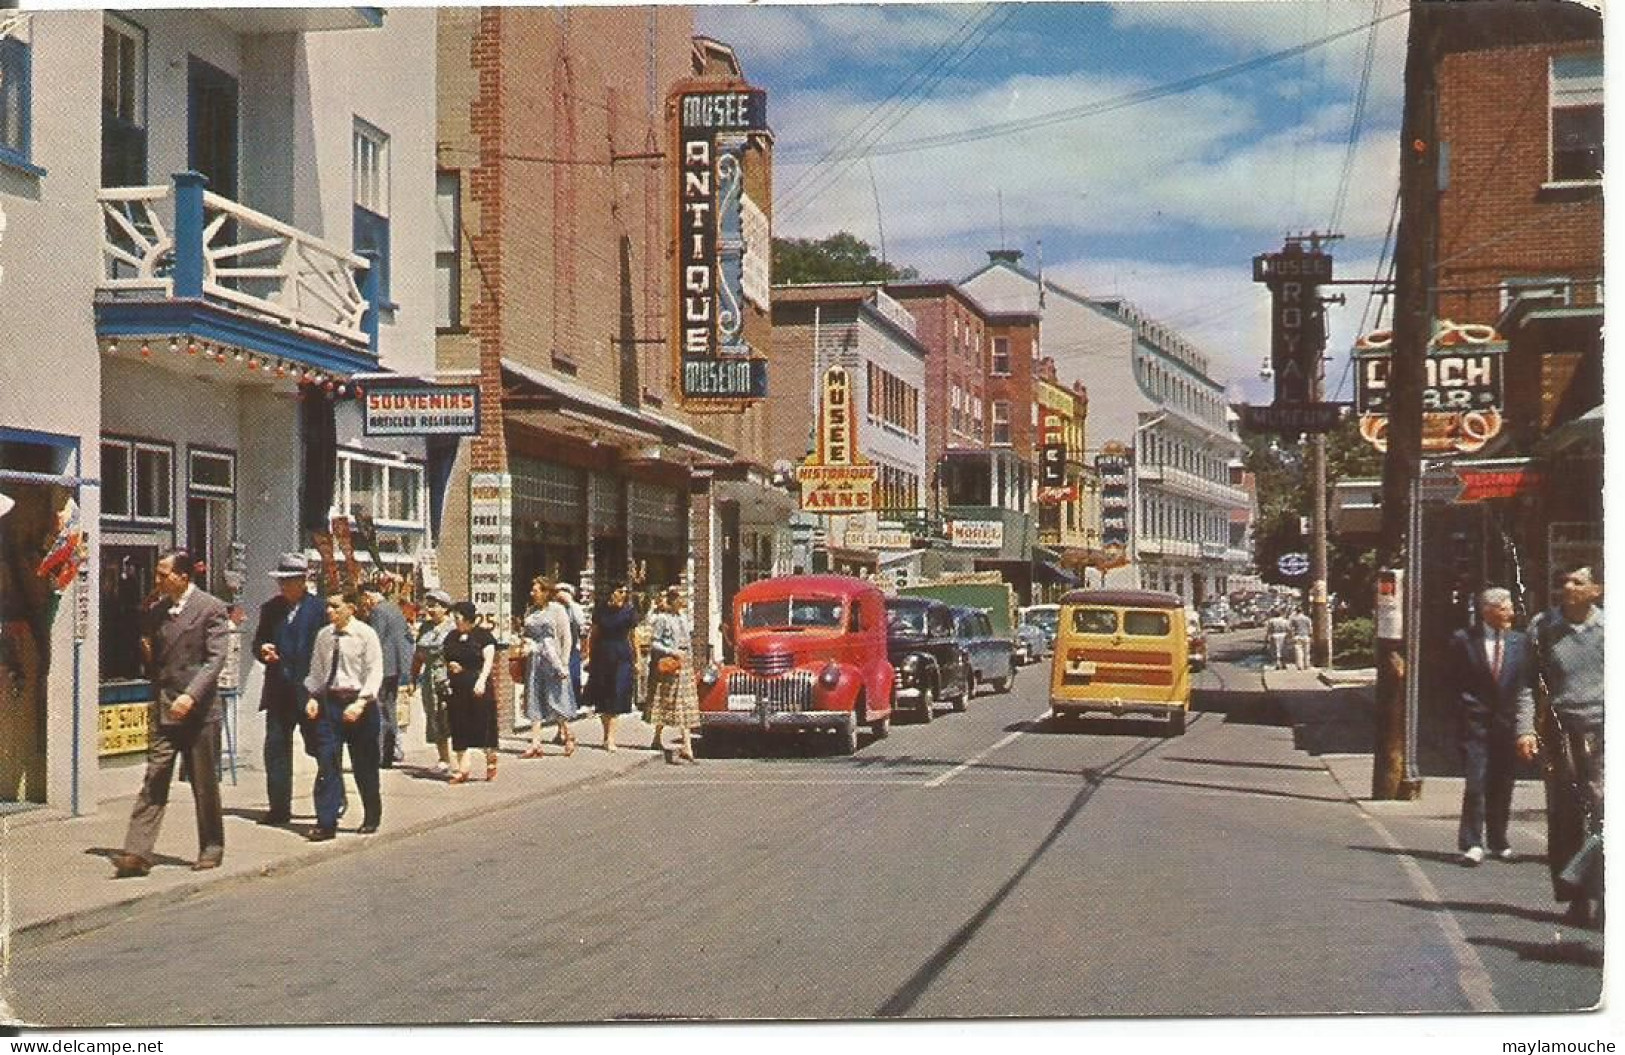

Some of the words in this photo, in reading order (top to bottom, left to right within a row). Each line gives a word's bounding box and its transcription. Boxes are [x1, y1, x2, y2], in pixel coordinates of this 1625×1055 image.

[686, 141, 709, 351] ANTIQUE
[1282, 282, 1301, 402] ROYAL
[685, 361, 750, 393] MUSEUM
[369, 394, 474, 410] SOUVENIRS
[828, 370, 846, 461] MUSEE
[799, 468, 877, 480] HISTORIQUE
[805, 491, 869, 507] ANNE
